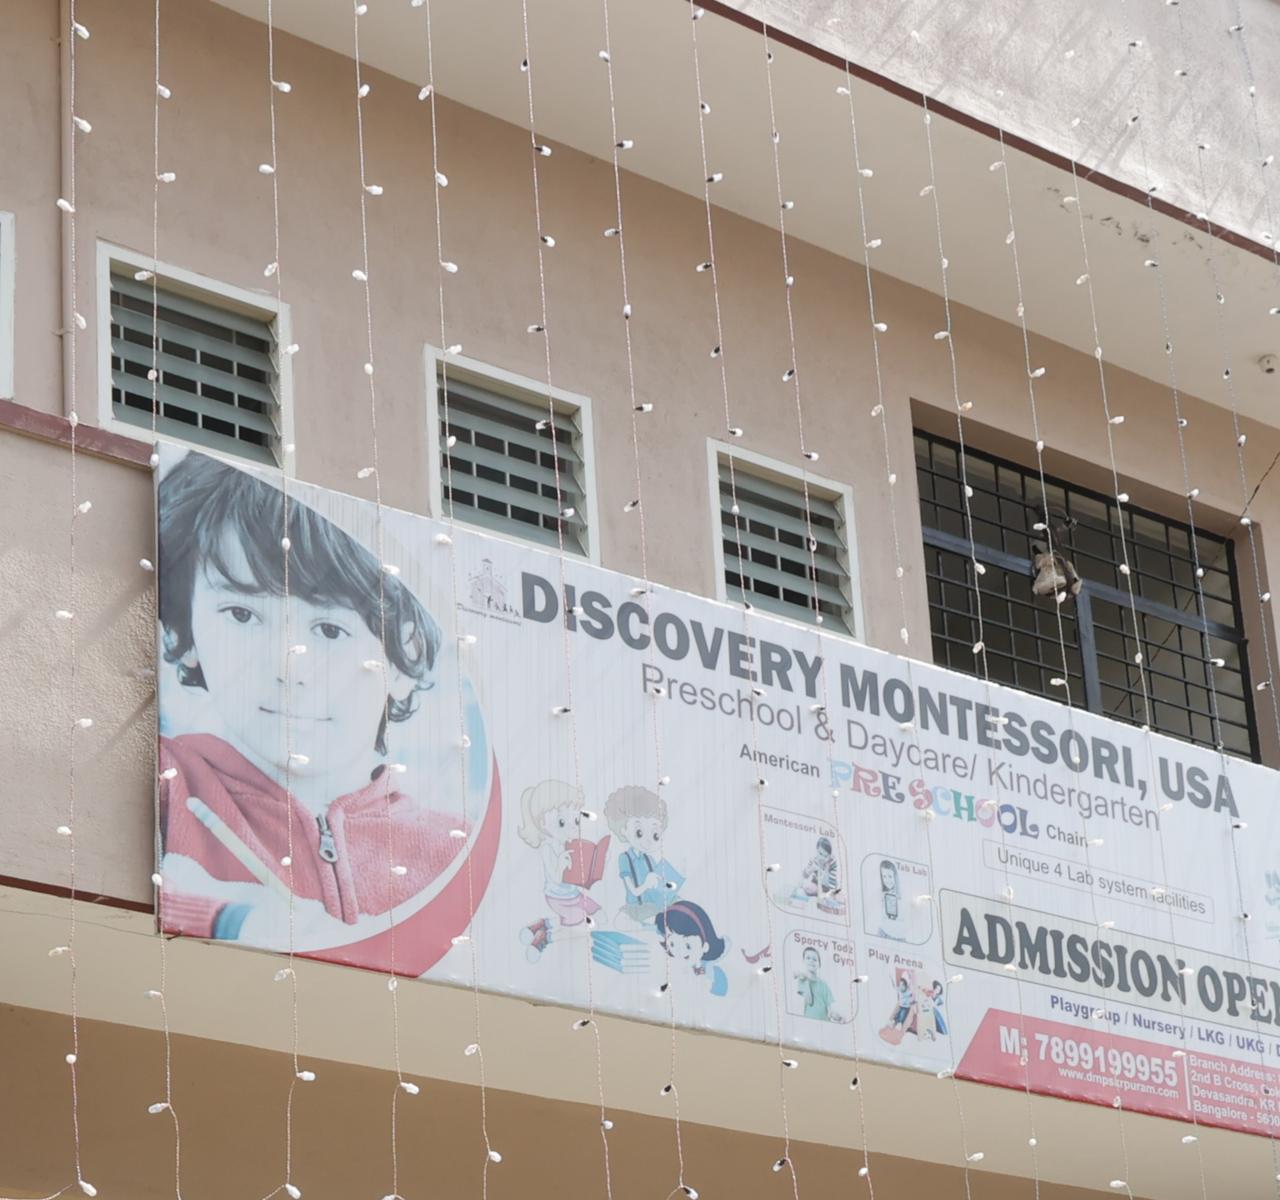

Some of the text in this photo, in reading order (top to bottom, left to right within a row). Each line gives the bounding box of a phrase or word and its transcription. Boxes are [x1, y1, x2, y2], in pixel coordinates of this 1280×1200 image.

[521, 571, 1240, 818] DISCOVERY MONTESSORI, USA
[641, 663, 1159, 831] Preschool & Daycare/ Kindergarten
[740, 744, 1088, 848] American PRE SCHOOL Chain
[764, 814, 836, 839] Montessori Lab
[896, 862, 928, 876] Tab Lab
[997, 848, 1051, 877] Unique
[1054, 863, 1063, 878] 4
[1067, 865, 1094, 886] Lab
[1098, 876, 1148, 901] system
[794, 932, 854, 954] Sporty Todz
[833, 953, 854, 967] Gym
[869, 949, 923, 969] Play Arena
[952, 907, 1187, 1006] ADMISSION
[1050, 995, 1121, 1025] Playgroup
[1132, 1015, 1186, 1040] Nursery
[1197, 1027, 1225, 1046] LKG
[1236, 1036, 1265, 1054] UKG
[1035, 1033, 1178, 1087] 7899199955
[1190, 1056, 1227, 1071] Branch
[1190, 1071, 1211, 1083] 2nd
[1214, 1075, 1222, 1086] B
[1194, 1101, 1248, 1121] Bangalore
[1260, 1099, 1275, 1111] KR
